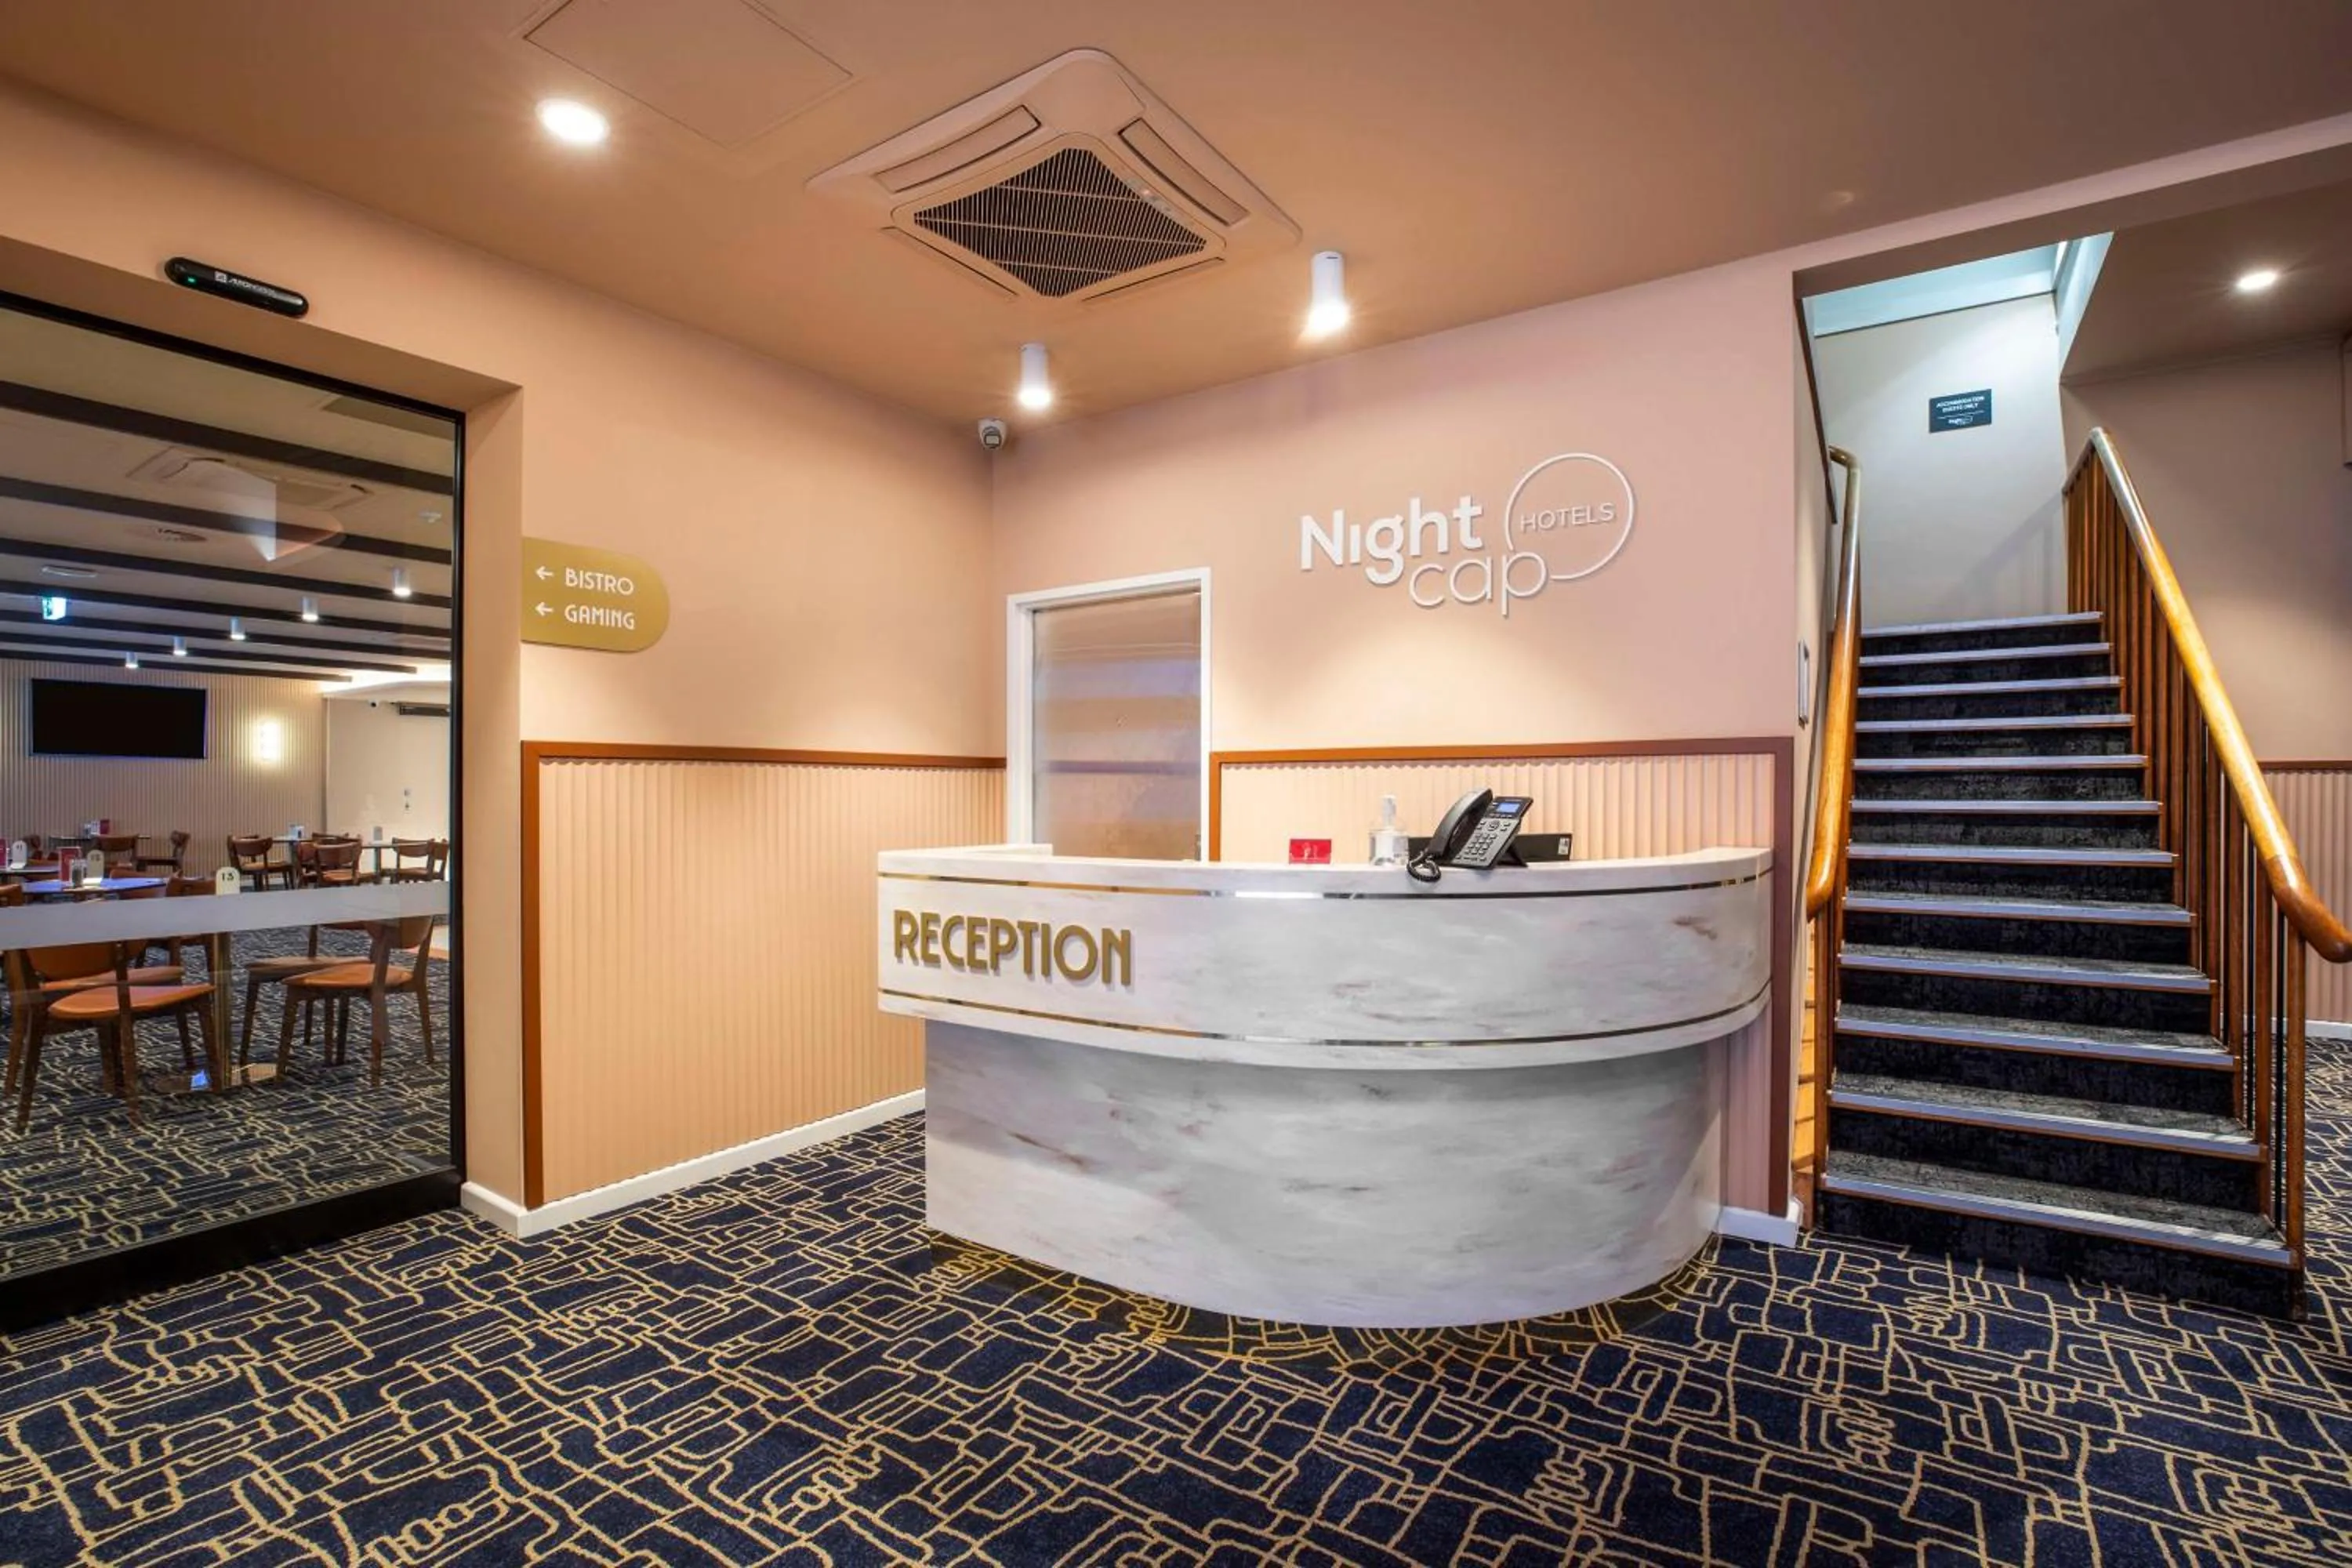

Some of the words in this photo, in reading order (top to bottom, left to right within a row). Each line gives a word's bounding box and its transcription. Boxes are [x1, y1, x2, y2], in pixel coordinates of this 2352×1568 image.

[1300, 495, 1483, 586] Night
[1520, 503, 1617, 532] HOTELS
[564, 567, 634, 595] BISTRO
[1410, 552, 1548, 616] cap
[564, 604, 636, 630] GAMING
[894, 909, 1131, 986] RECEPTION
